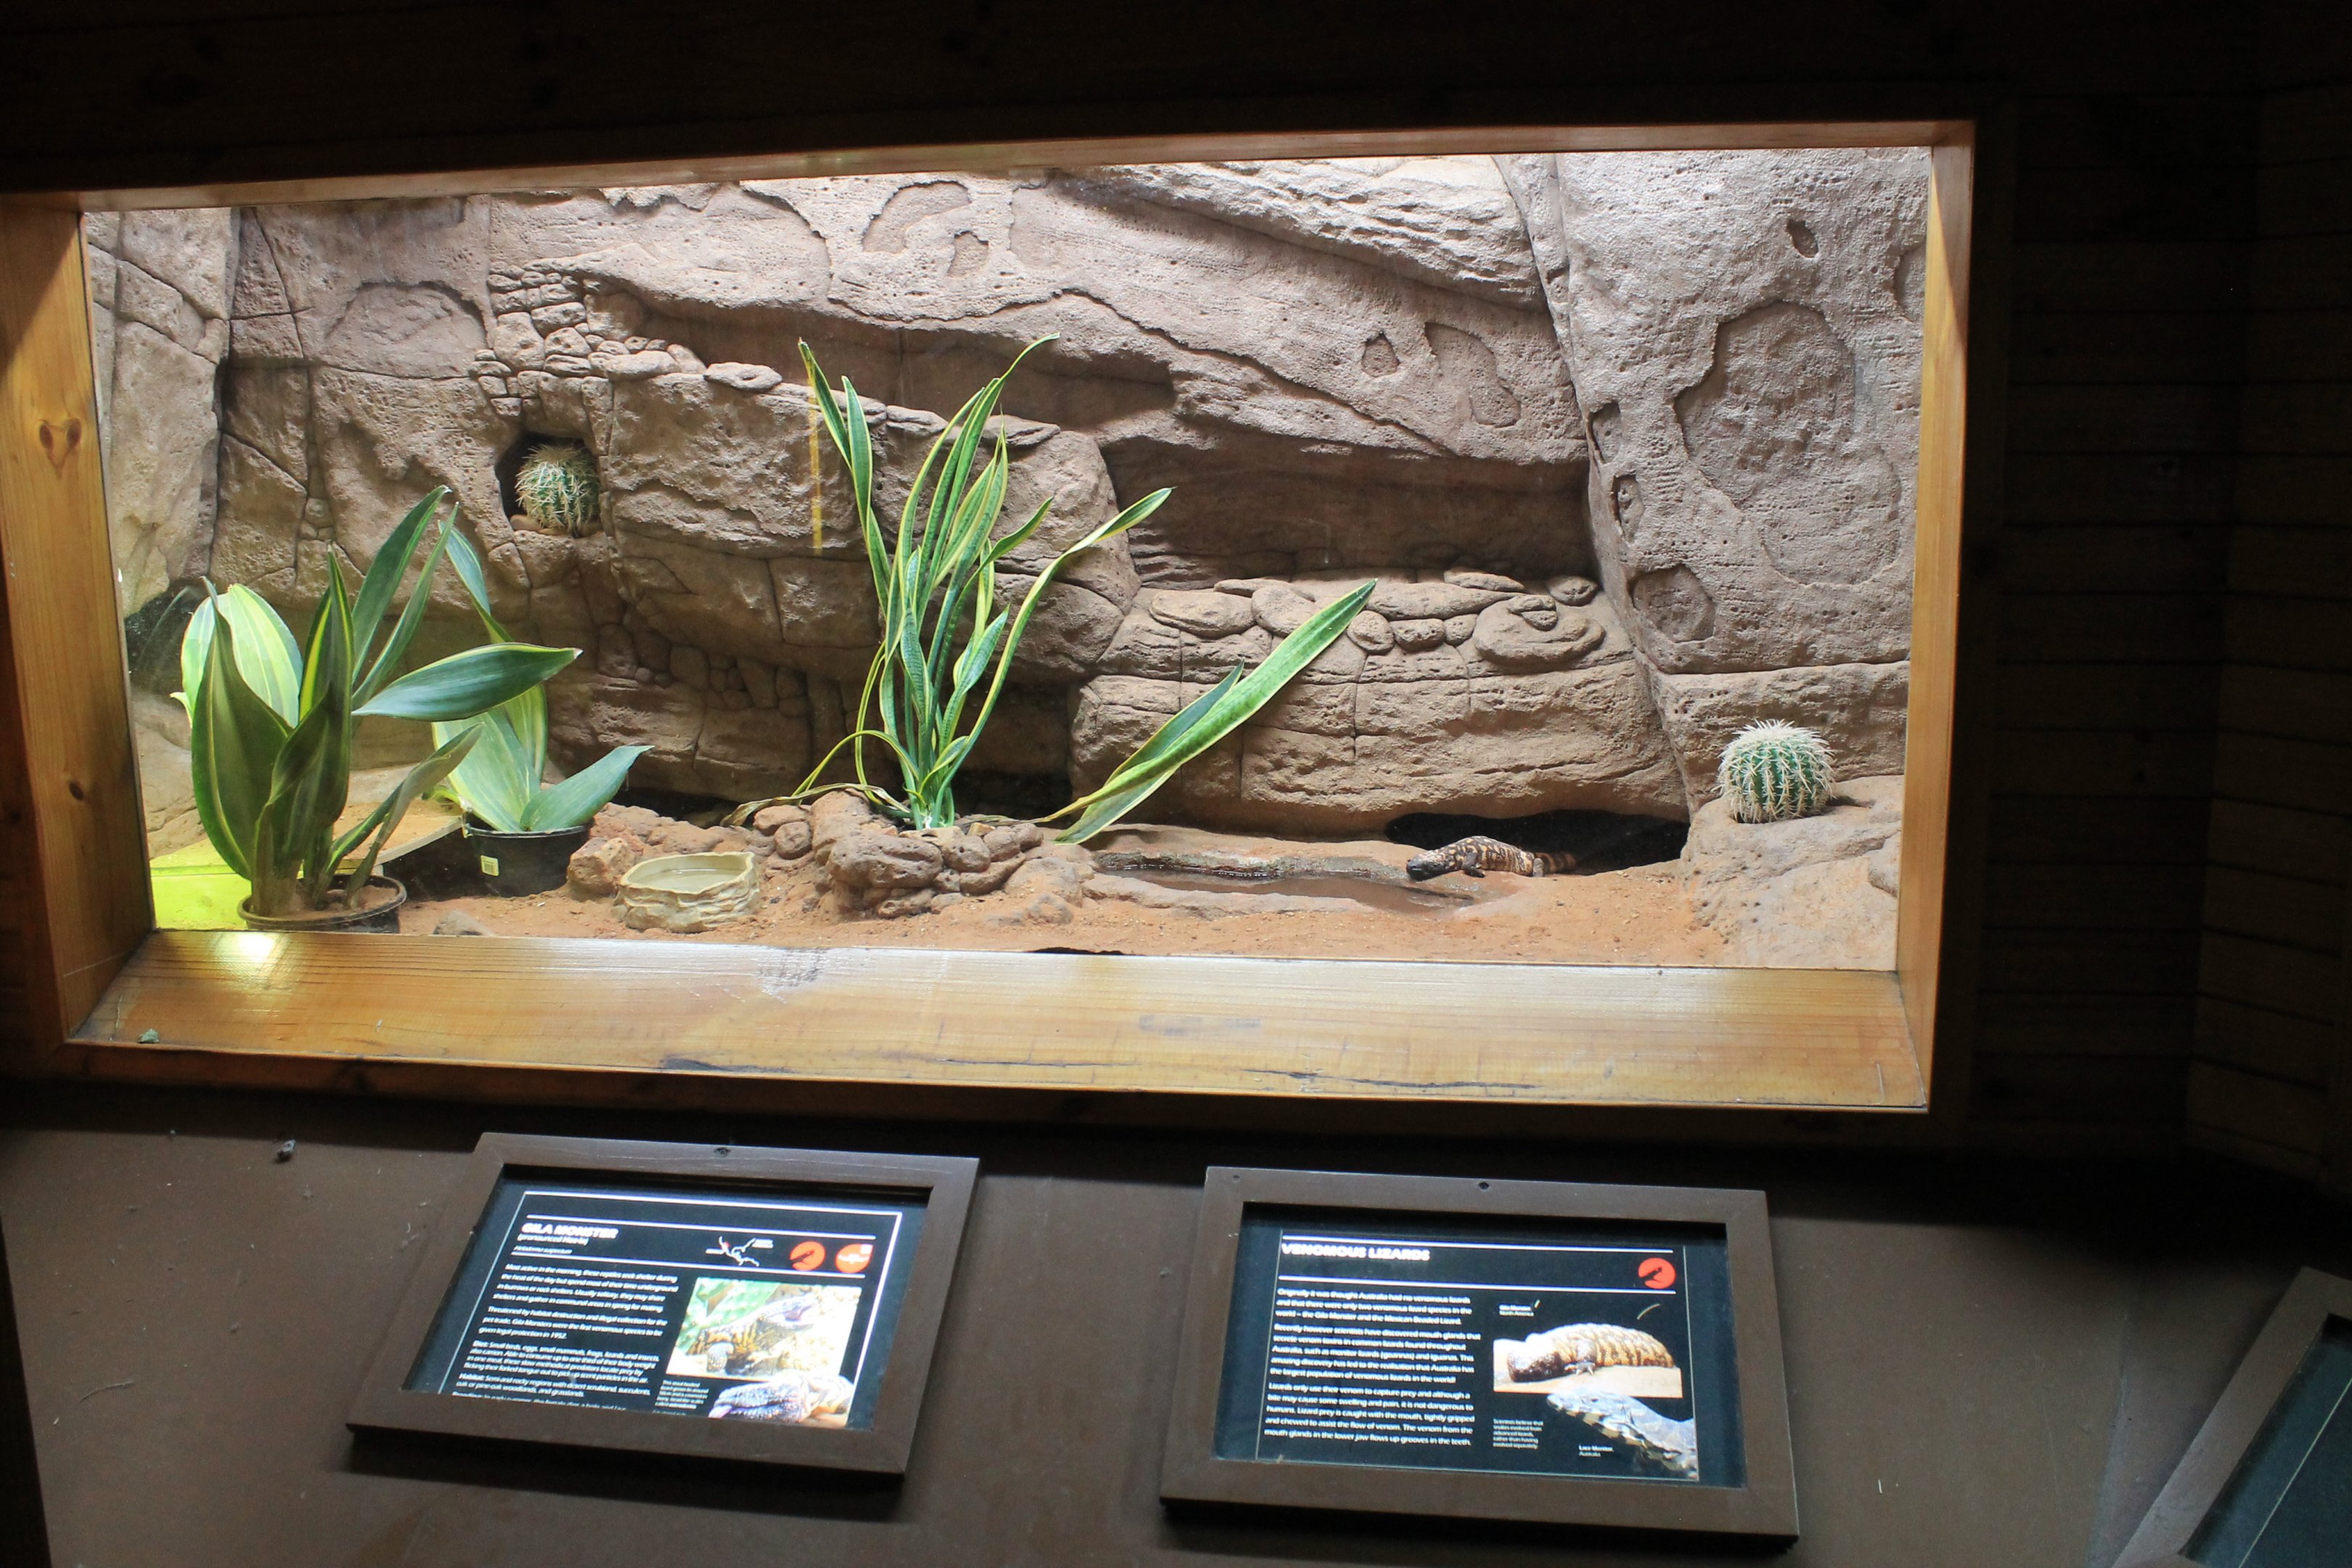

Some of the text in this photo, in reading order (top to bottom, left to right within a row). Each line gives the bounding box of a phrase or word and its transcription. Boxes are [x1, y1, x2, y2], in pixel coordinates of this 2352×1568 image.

[520, 1222, 619, 1238] GILA MONSTER
[1280, 1244, 1430, 1260] VENOMOUS LIZARDS
[1293, 1384, 1308, 1392] only
[1373, 1387, 1400, 1397] capture
[1432, 1390, 1464, 1400] although
[1338, 1397, 1367, 1406] swelling
[1426, 1402, 1464, 1411] dangerous
[1280, 1416, 1308, 1426] chewed
[1318, 1418, 1336, 1427] assist
[1342, 1408, 1367, 1418] caught
[1424, 1413, 1446, 1423] tightly
[1447, 1414, 1474, 1424] gripped
[1264, 1427, 1288, 1436] mouth
[1288, 1429, 1312, 1439] glands
[1321, 1430, 1334, 1439] the
[1334, 1431, 1354, 1440] lower
[1355, 1433, 1368, 1442] jaw
[1369, 1433, 1388, 1442] flows
[1400, 1436, 1429, 1445] grooves
[1438, 1437, 1450, 1445] the
